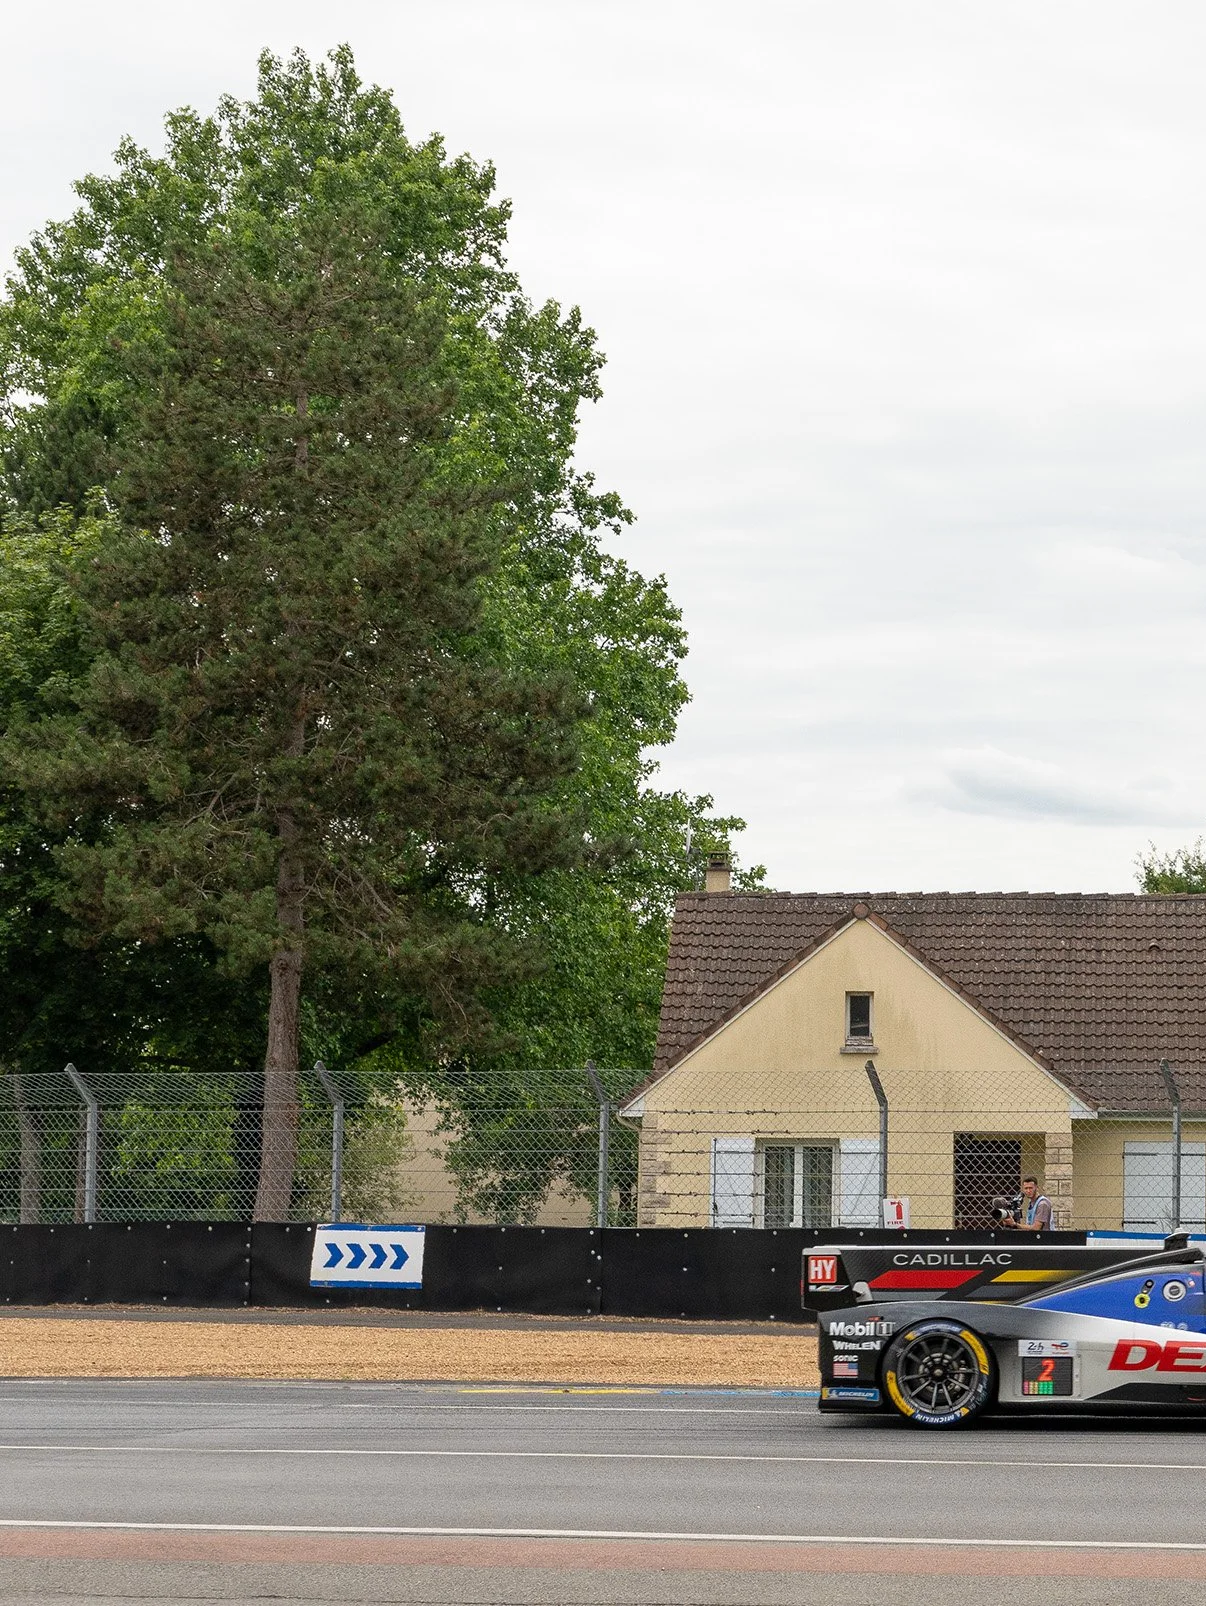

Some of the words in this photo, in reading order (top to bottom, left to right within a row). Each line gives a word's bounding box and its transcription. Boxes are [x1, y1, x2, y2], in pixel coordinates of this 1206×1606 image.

[893, 1253, 1012, 1265] CADILLAC
[810, 1259, 834, 1280] HY
[829, 1322, 875, 1336] Mobil
[832, 1340, 881, 1350] WHELEN
[1037, 1358, 1055, 1381] 2
[915, 1413, 955, 1423] MICHELIN
